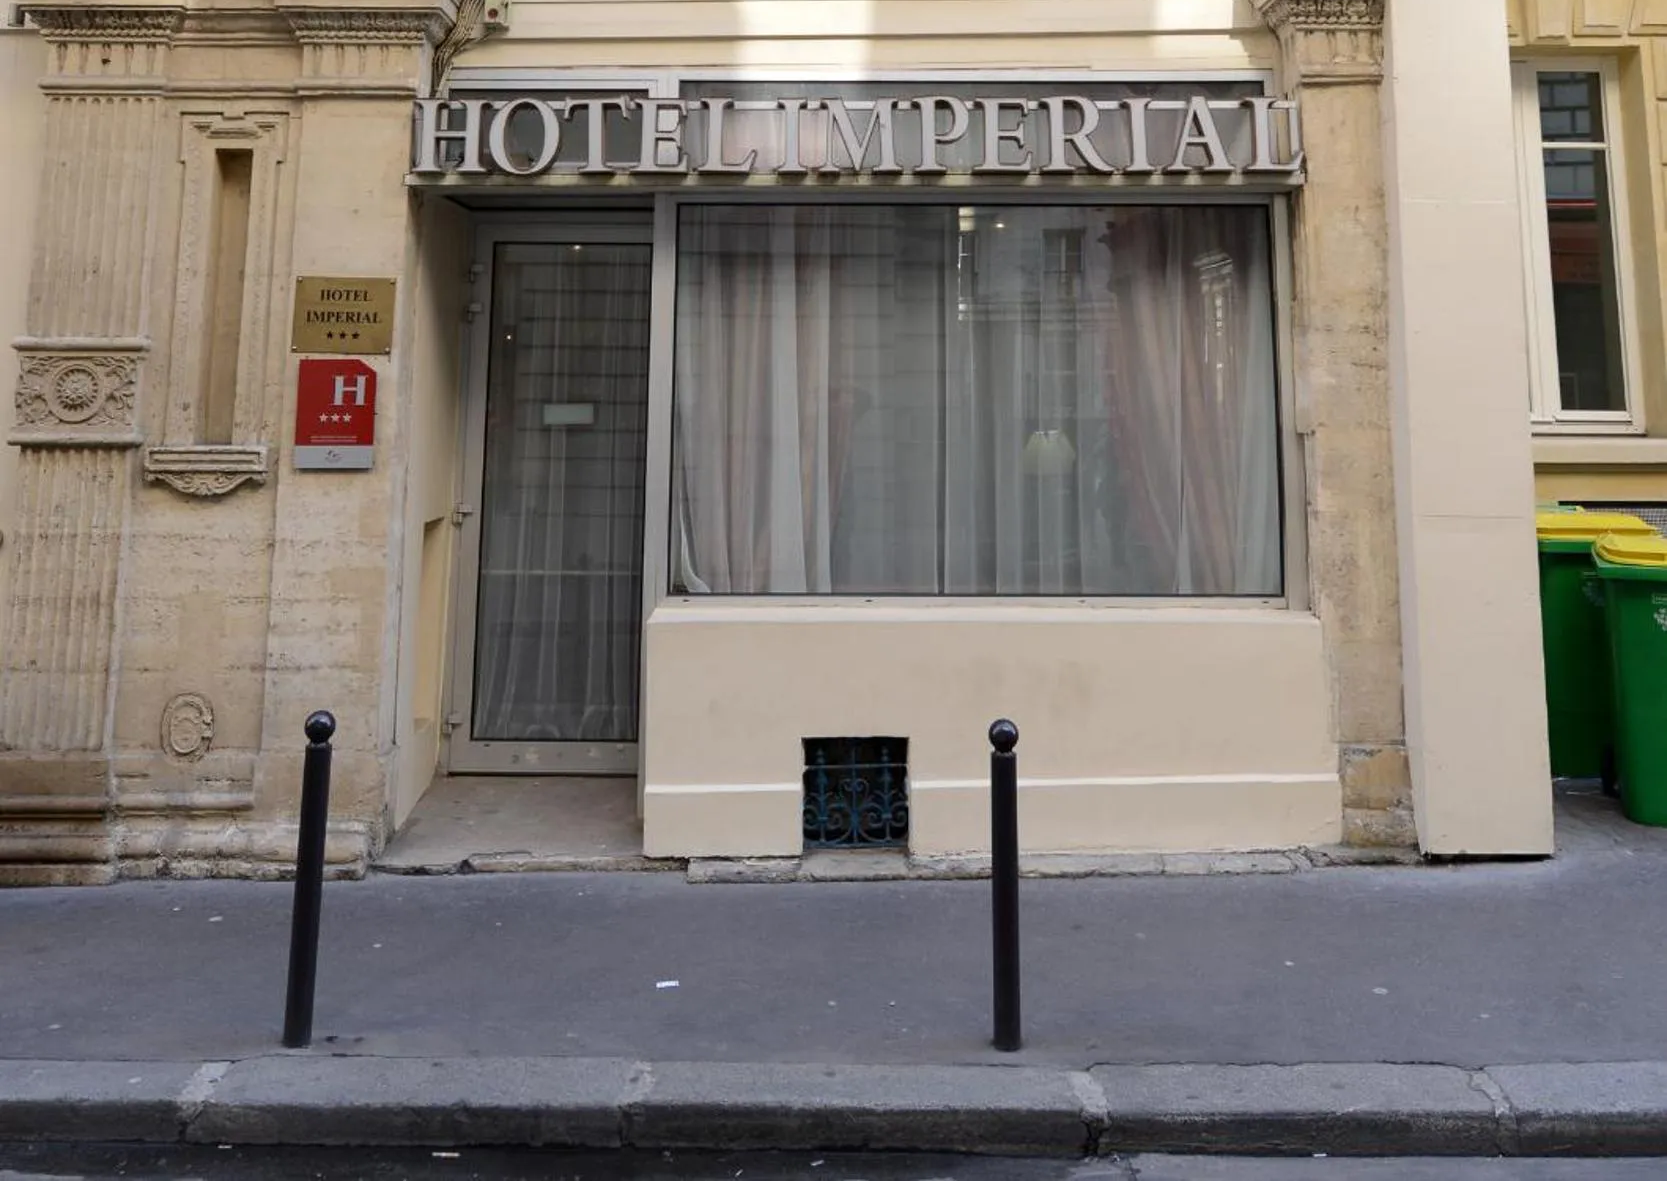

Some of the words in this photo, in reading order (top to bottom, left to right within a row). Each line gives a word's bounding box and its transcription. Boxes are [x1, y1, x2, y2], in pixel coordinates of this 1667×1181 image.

[413, 96, 757, 175] HOTEL
[776, 95, 1304, 173] IMPERIAL
[320, 289, 373, 302] HOTEL
[306, 311, 382, 324] IMPERIAL
[332, 374, 368, 406] H
